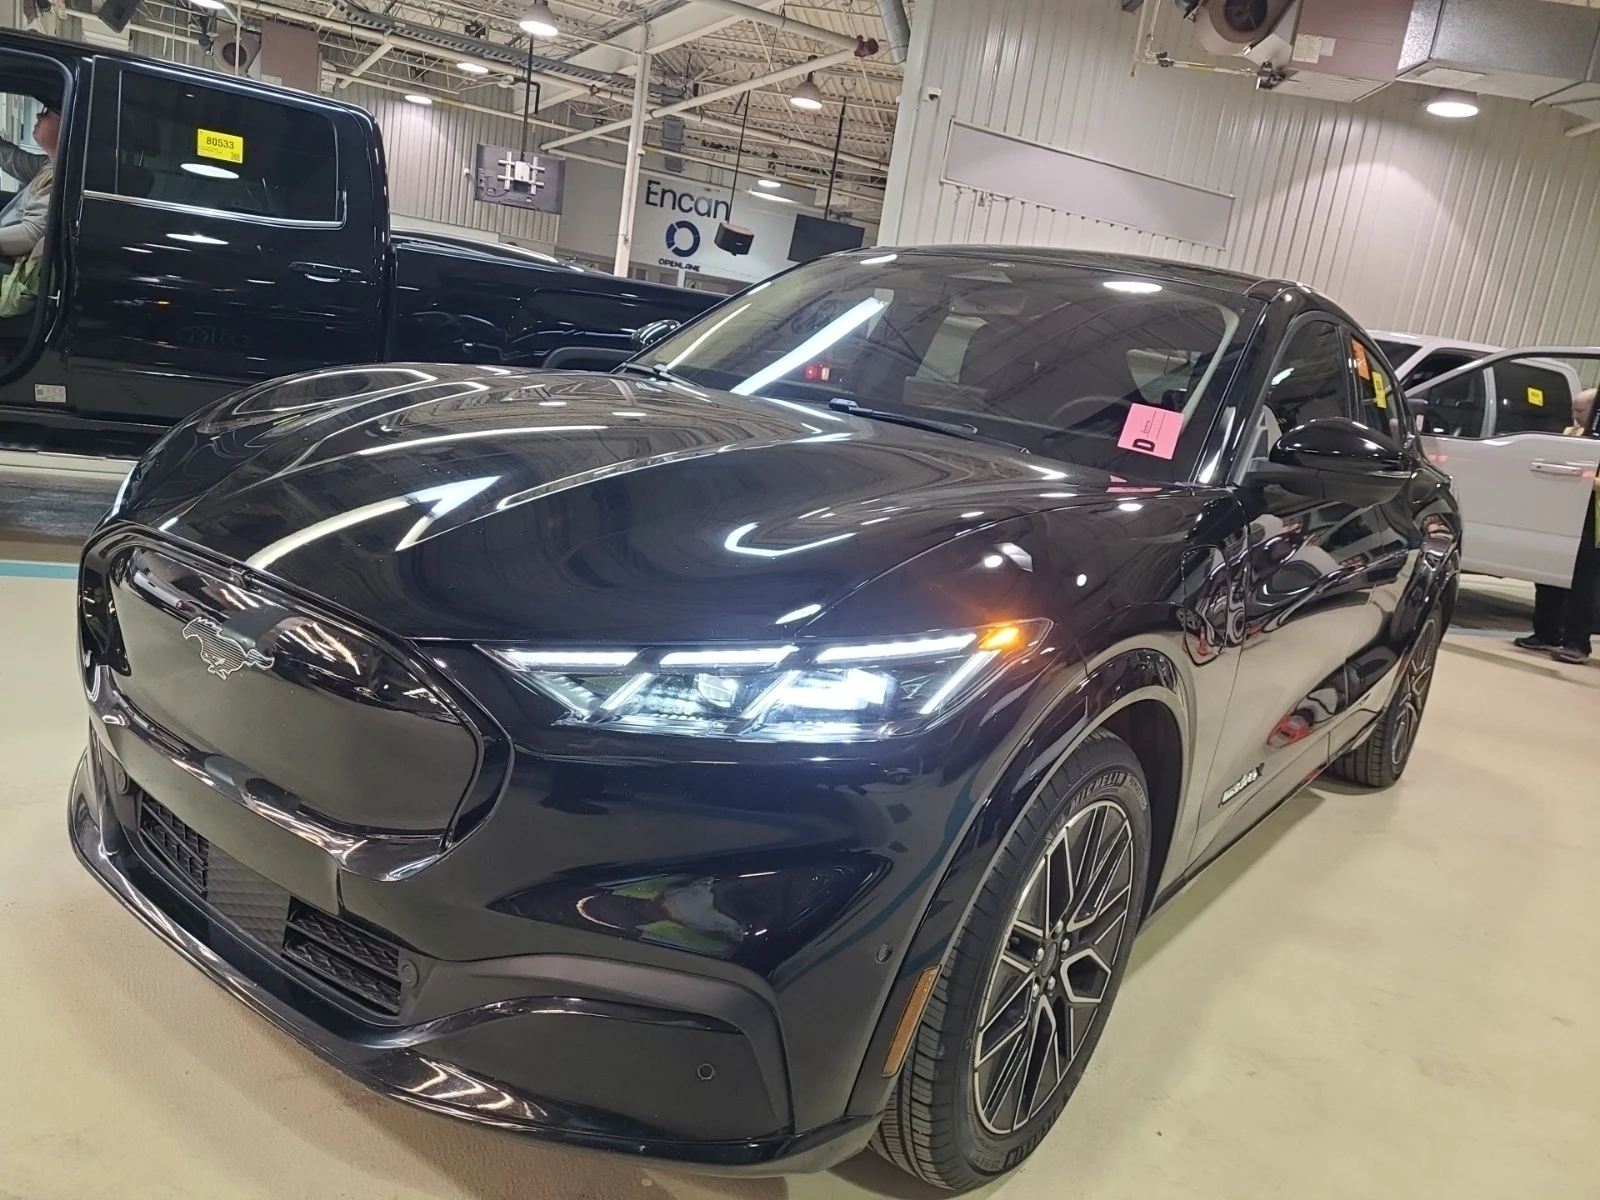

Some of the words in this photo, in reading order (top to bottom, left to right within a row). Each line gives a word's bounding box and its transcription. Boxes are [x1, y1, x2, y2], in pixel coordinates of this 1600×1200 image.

[207, 136, 235, 150] 80533
[644, 179, 730, 222] Encan
[658, 258, 701, 272] OPENLANE
[1132, 439, 1155, 452] D
